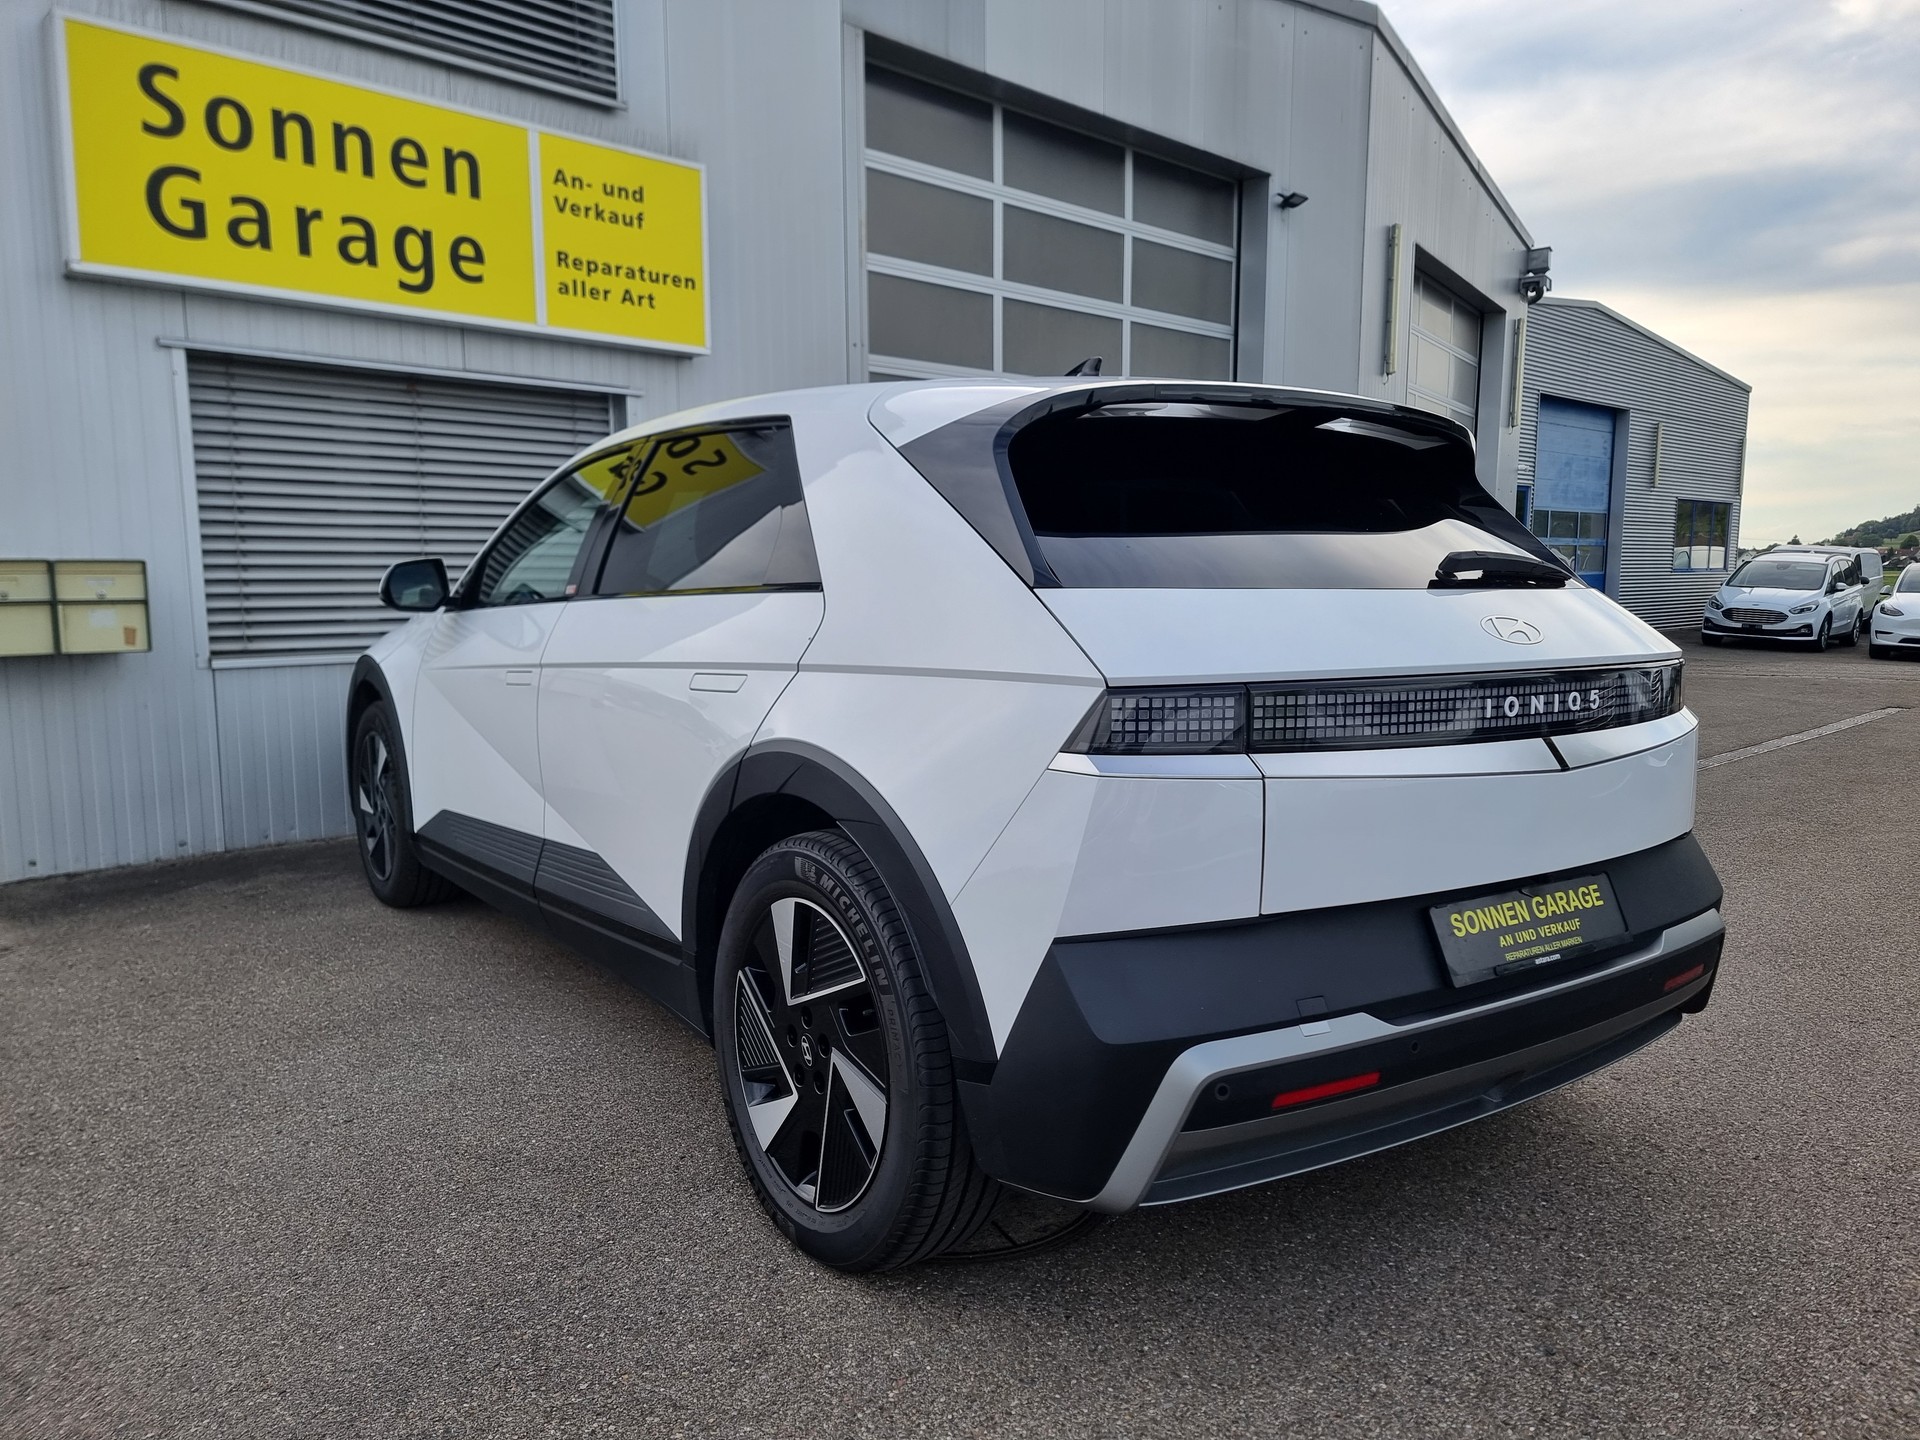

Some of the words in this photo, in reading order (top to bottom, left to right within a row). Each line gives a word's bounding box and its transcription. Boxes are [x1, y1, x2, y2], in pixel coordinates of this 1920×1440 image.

[137, 62, 481, 200] Sonnen
[553, 168, 593, 190] An-
[602, 182, 645, 203] und
[145, 165, 486, 294] Garage
[553, 195, 645, 230] Verkauf
[557, 250, 697, 291] Reparaturen
[557, 278, 612, 301] aller
[620, 288, 656, 310] Art
[820, 873, 889, 986] MICHELIN
[1450, 899, 1531, 937] SONNEN
[1531, 884, 1604, 919] GARAGE
[1499, 934, 1514, 947] AN
[1515, 928, 1537, 944] UND
[1537, 918, 1581, 937] VERKAUF
[1505, 945, 1545, 961] REPARATUREN
[1545, 941, 1562, 951] ALLER
[1561, 936, 1583, 947] MARKEN
